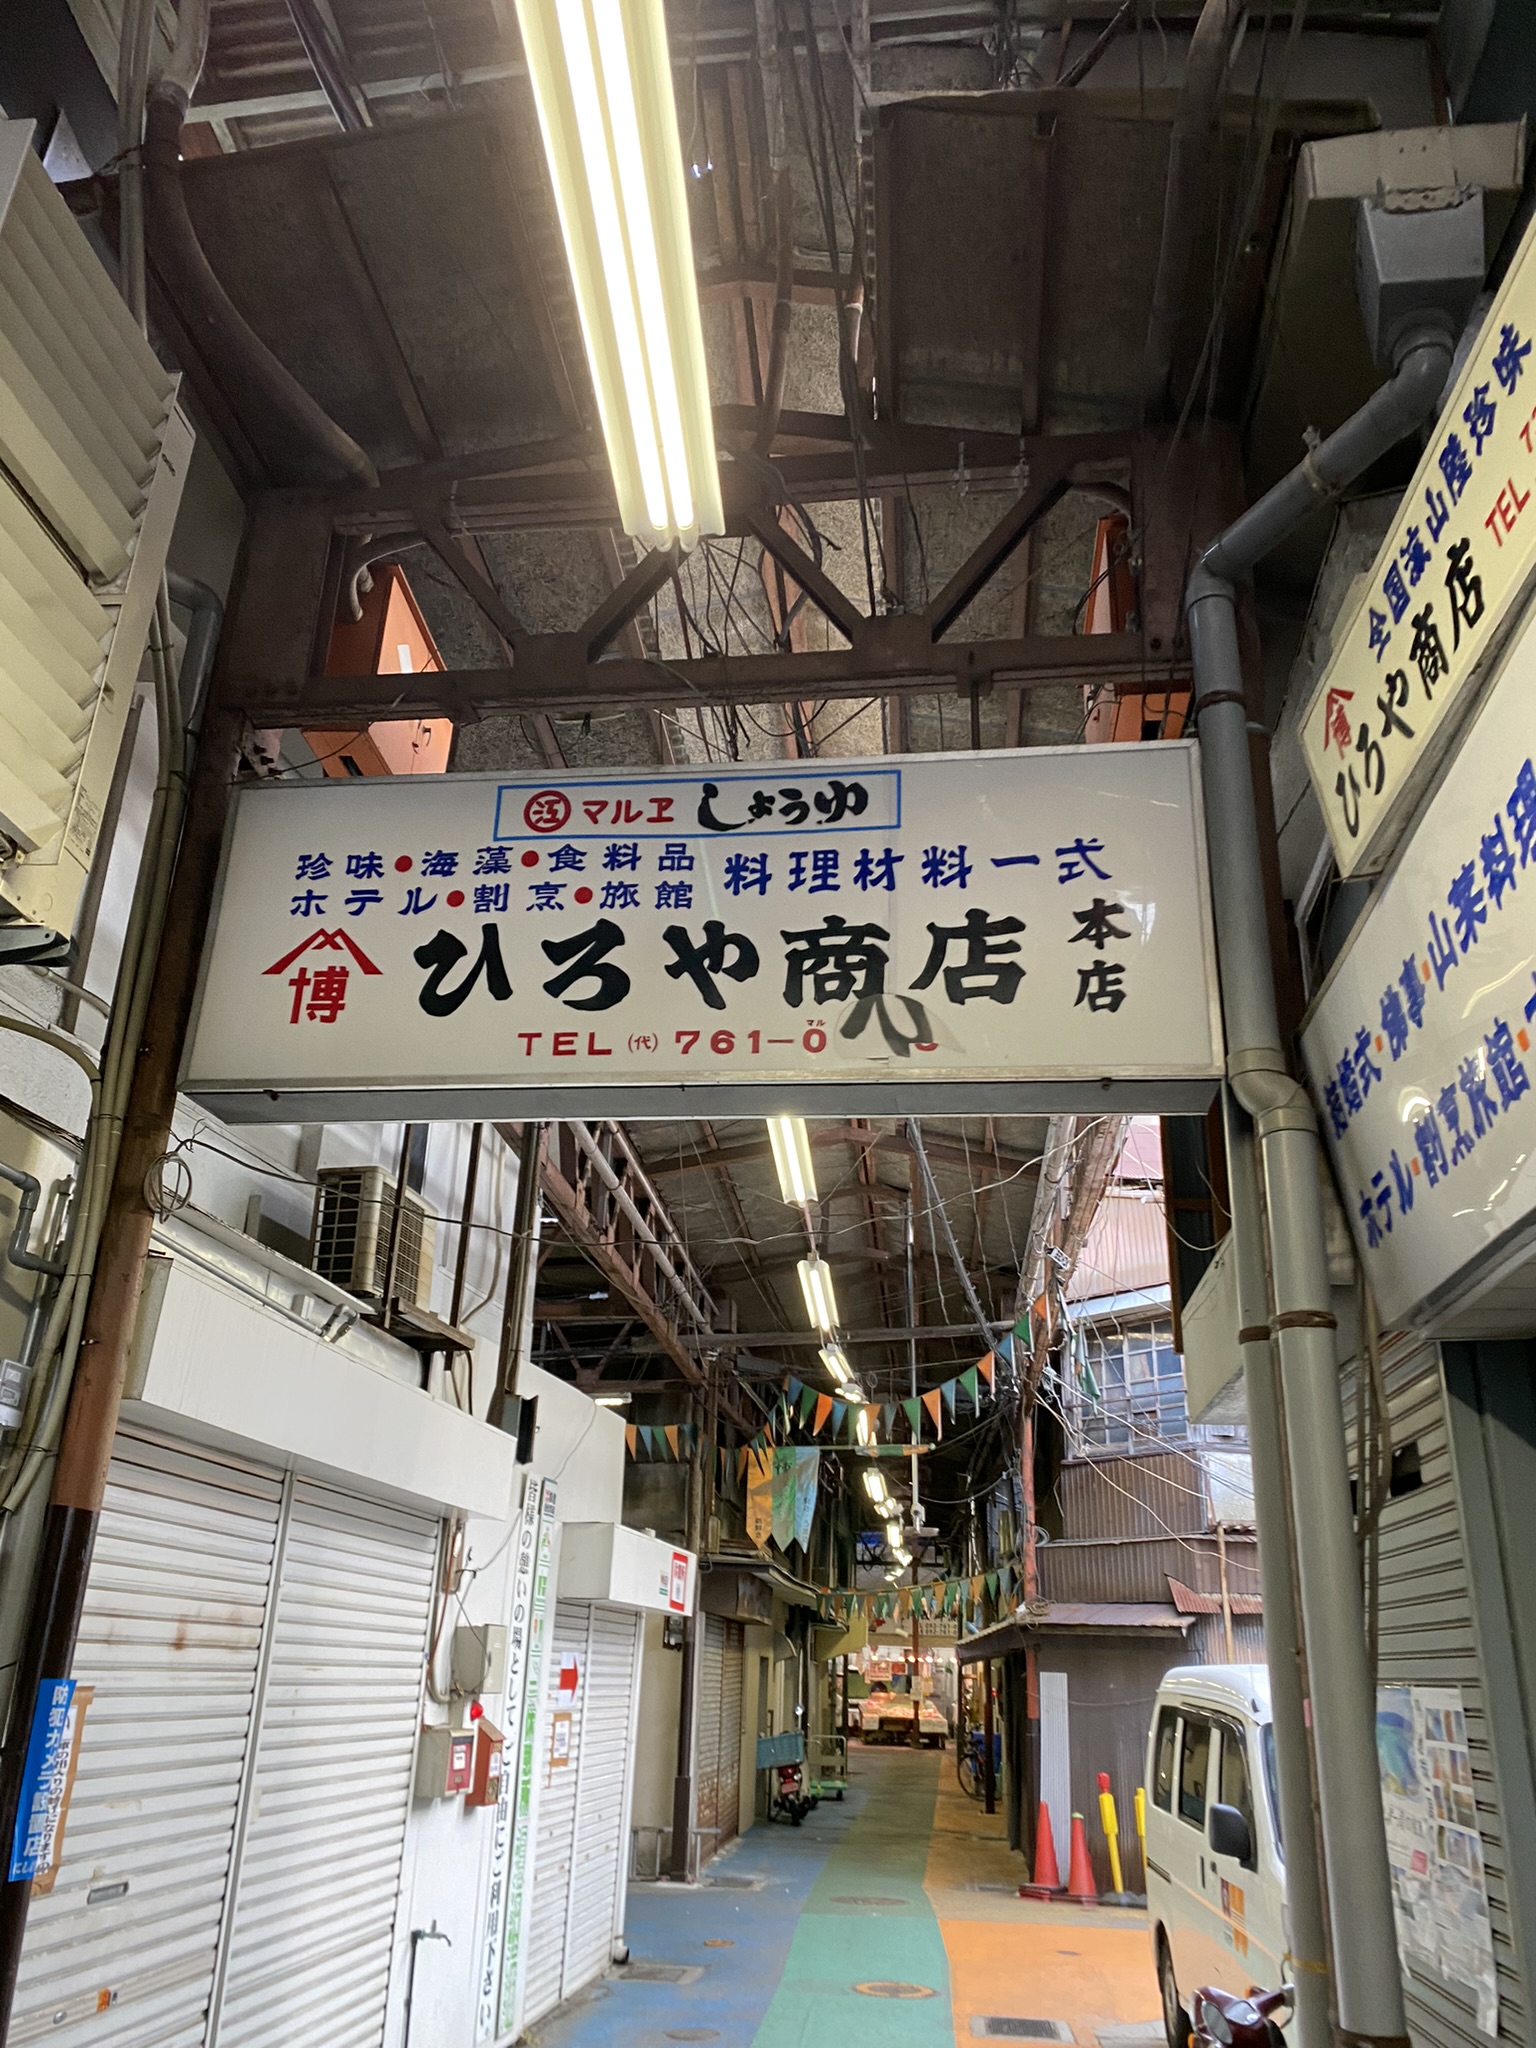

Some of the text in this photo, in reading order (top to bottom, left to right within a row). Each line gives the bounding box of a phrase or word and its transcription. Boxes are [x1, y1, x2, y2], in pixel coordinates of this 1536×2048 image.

[1485, 478, 1531, 547] TEL
[1336, 538, 1485, 837] ひろや商店
[697, 781, 868, 832] しょうゆ
[723, 838, 1113, 896] 料理材料一式
[413, 908, 1026, 1018] ひろや商店
[1068, 898, 1131, 1013] 本店
[518, 1032, 613, 1056] TEL
